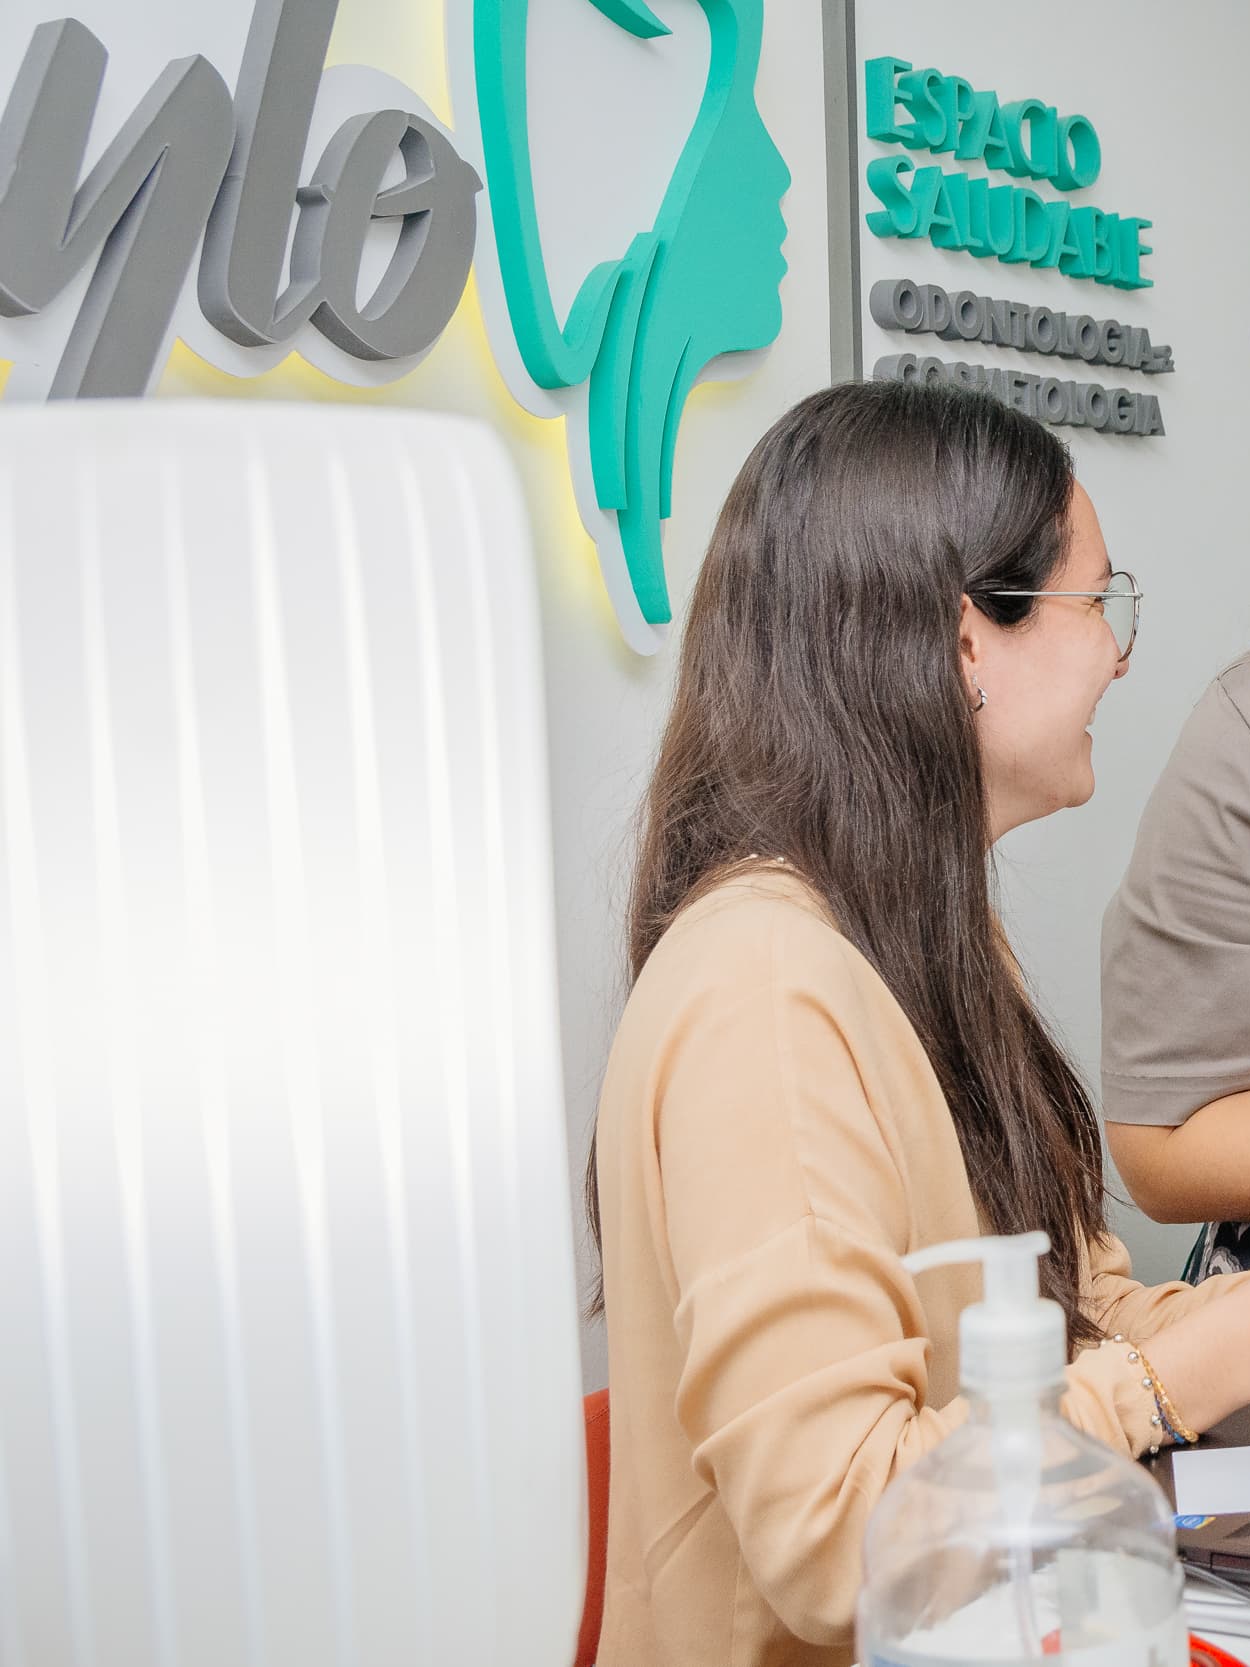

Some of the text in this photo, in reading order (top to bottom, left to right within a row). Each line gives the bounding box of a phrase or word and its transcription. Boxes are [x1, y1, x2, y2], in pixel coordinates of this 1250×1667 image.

[865, 56, 1101, 191] ESPACIO
[865, 155, 1154, 290] SALUDABLE
[870, 279, 1152, 368] ODONTOLOGIA
